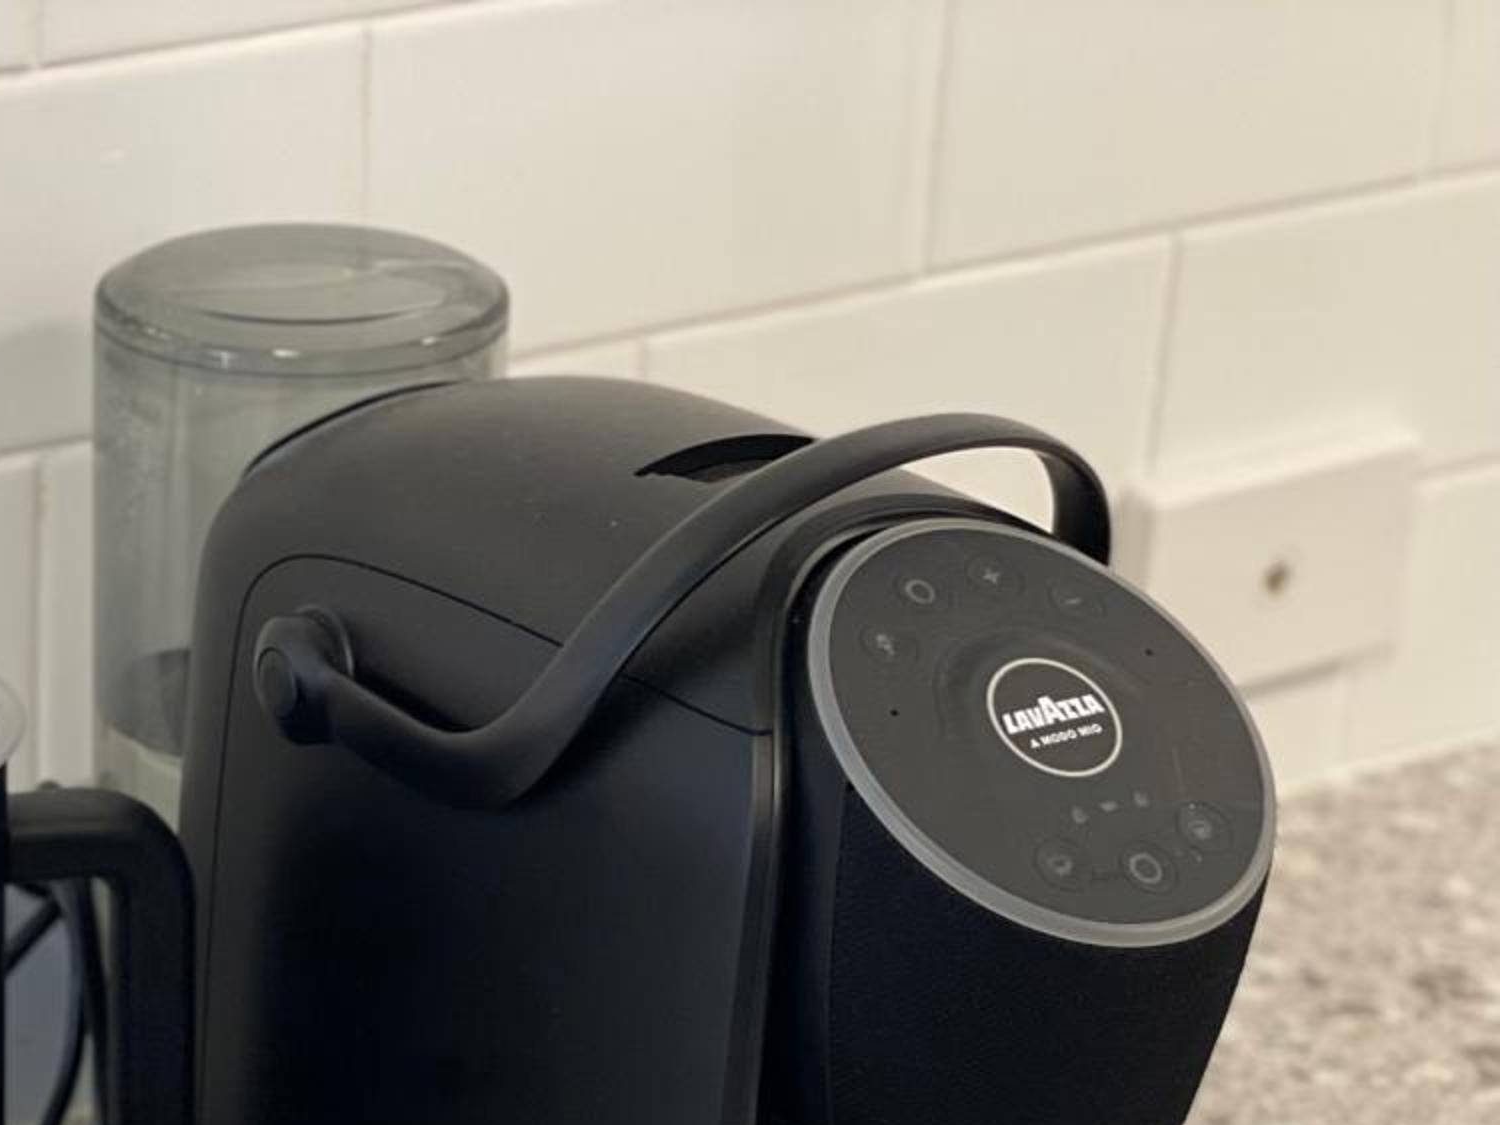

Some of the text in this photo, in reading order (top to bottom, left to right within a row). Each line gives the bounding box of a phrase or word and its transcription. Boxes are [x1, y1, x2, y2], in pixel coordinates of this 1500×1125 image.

[1002, 694, 1105, 735] LAVAZZA
[1031, 723, 1102, 749] A MODO MIO
